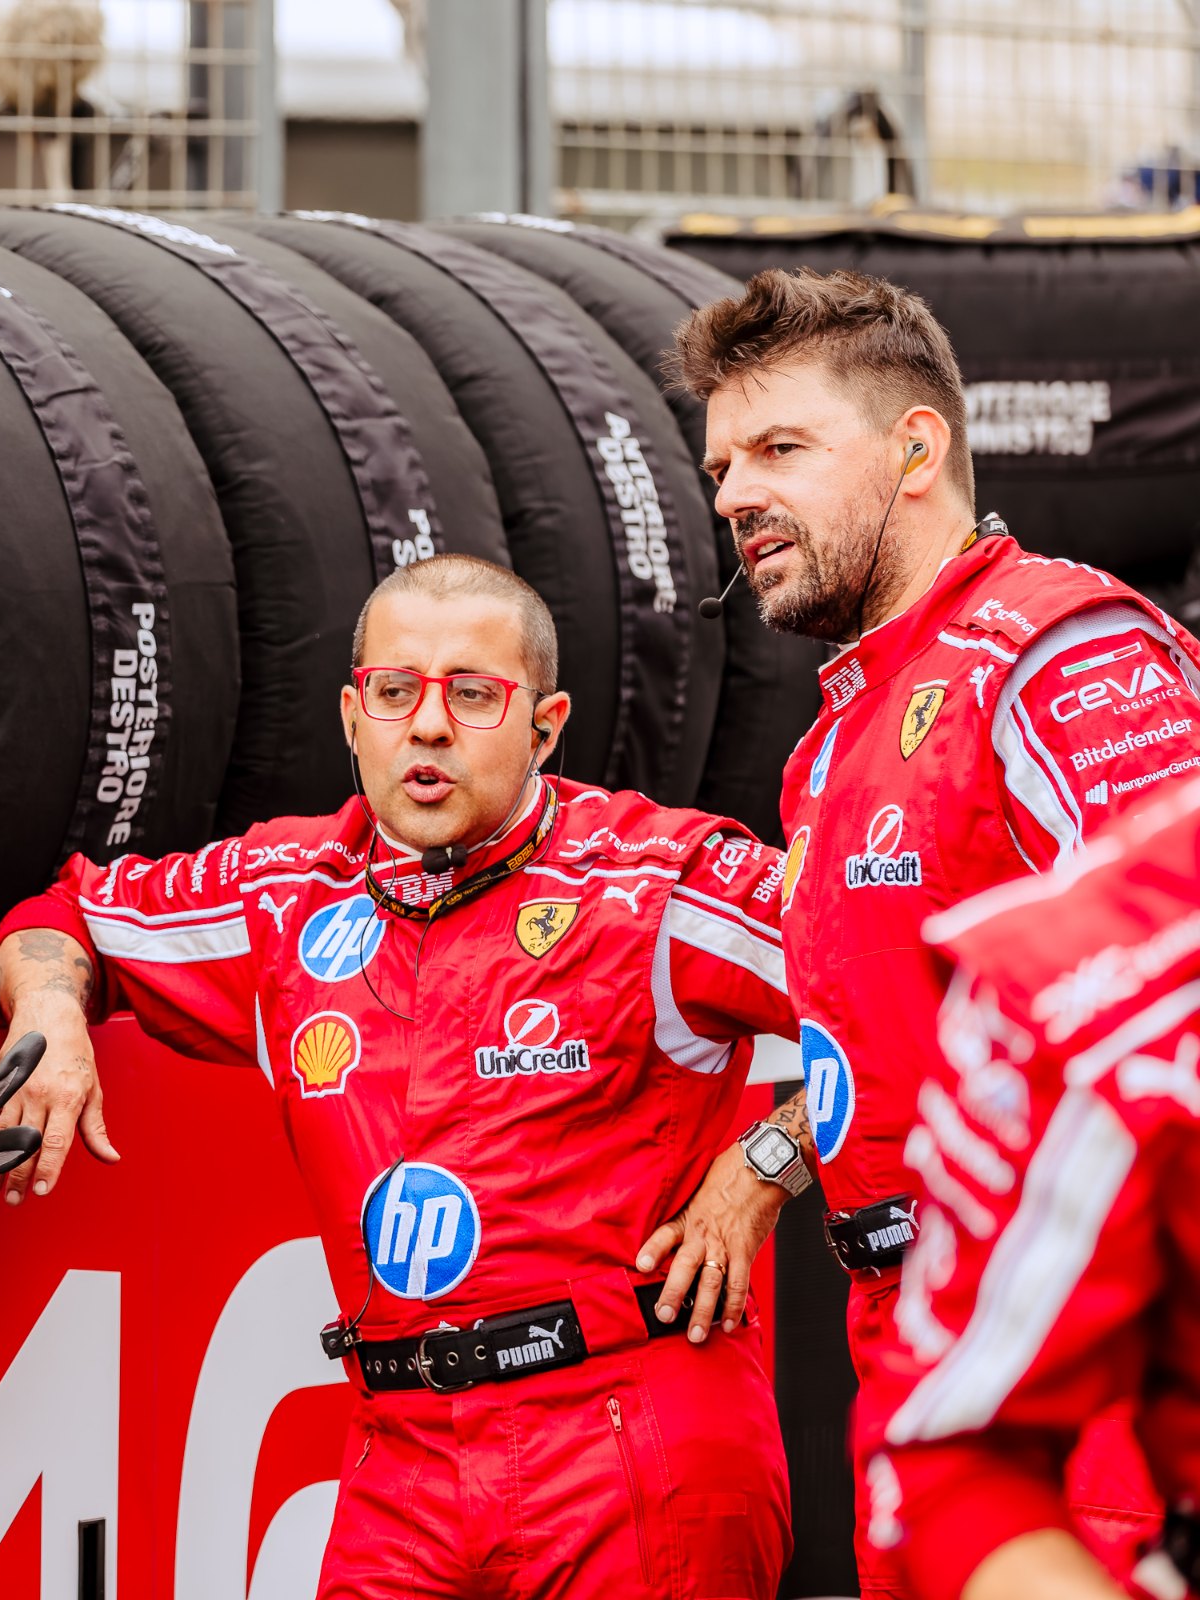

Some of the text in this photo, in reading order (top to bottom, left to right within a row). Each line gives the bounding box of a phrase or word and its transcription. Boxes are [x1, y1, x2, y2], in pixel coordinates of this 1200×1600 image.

[1113, 687, 1181, 715] LOGISTICS
[96, 649, 139, 804] DESTRO
[106, 602, 159, 846] POSTERIORE
[1069, 718, 1193, 772] Bitdefender
[506, 841, 535, 872] 2025
[848, 855, 920, 887] UniCredit
[381, 867, 455, 907] IBM
[305, 899, 381, 978] hp
[478, 1043, 587, 1076] UniCredit
[375, 1161, 463, 1295] hp
[866, 1221, 915, 1252] PUMA
[496, 1339, 556, 1371] PUMA
